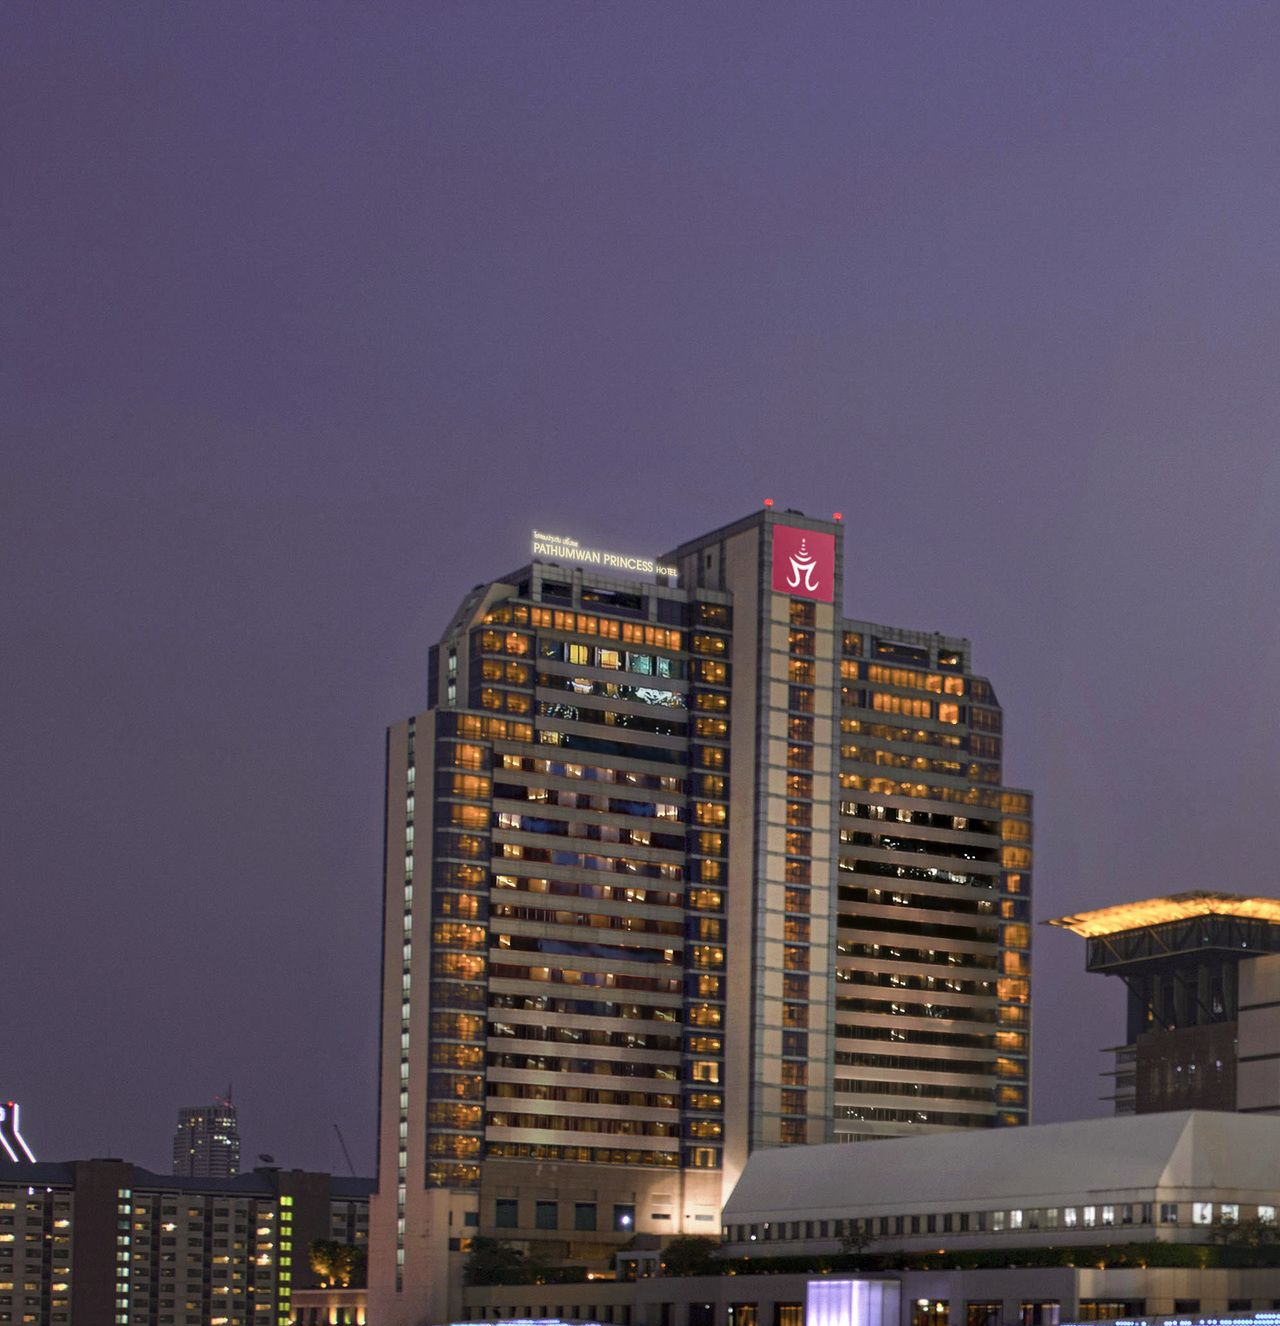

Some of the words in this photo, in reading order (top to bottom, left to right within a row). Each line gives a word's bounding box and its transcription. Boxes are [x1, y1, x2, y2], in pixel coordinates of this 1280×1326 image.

[533, 542, 601, 564] PATHUMWAN
[603, 554, 654, 573] PRINCESS
[656, 566, 678, 576] HOTEL
